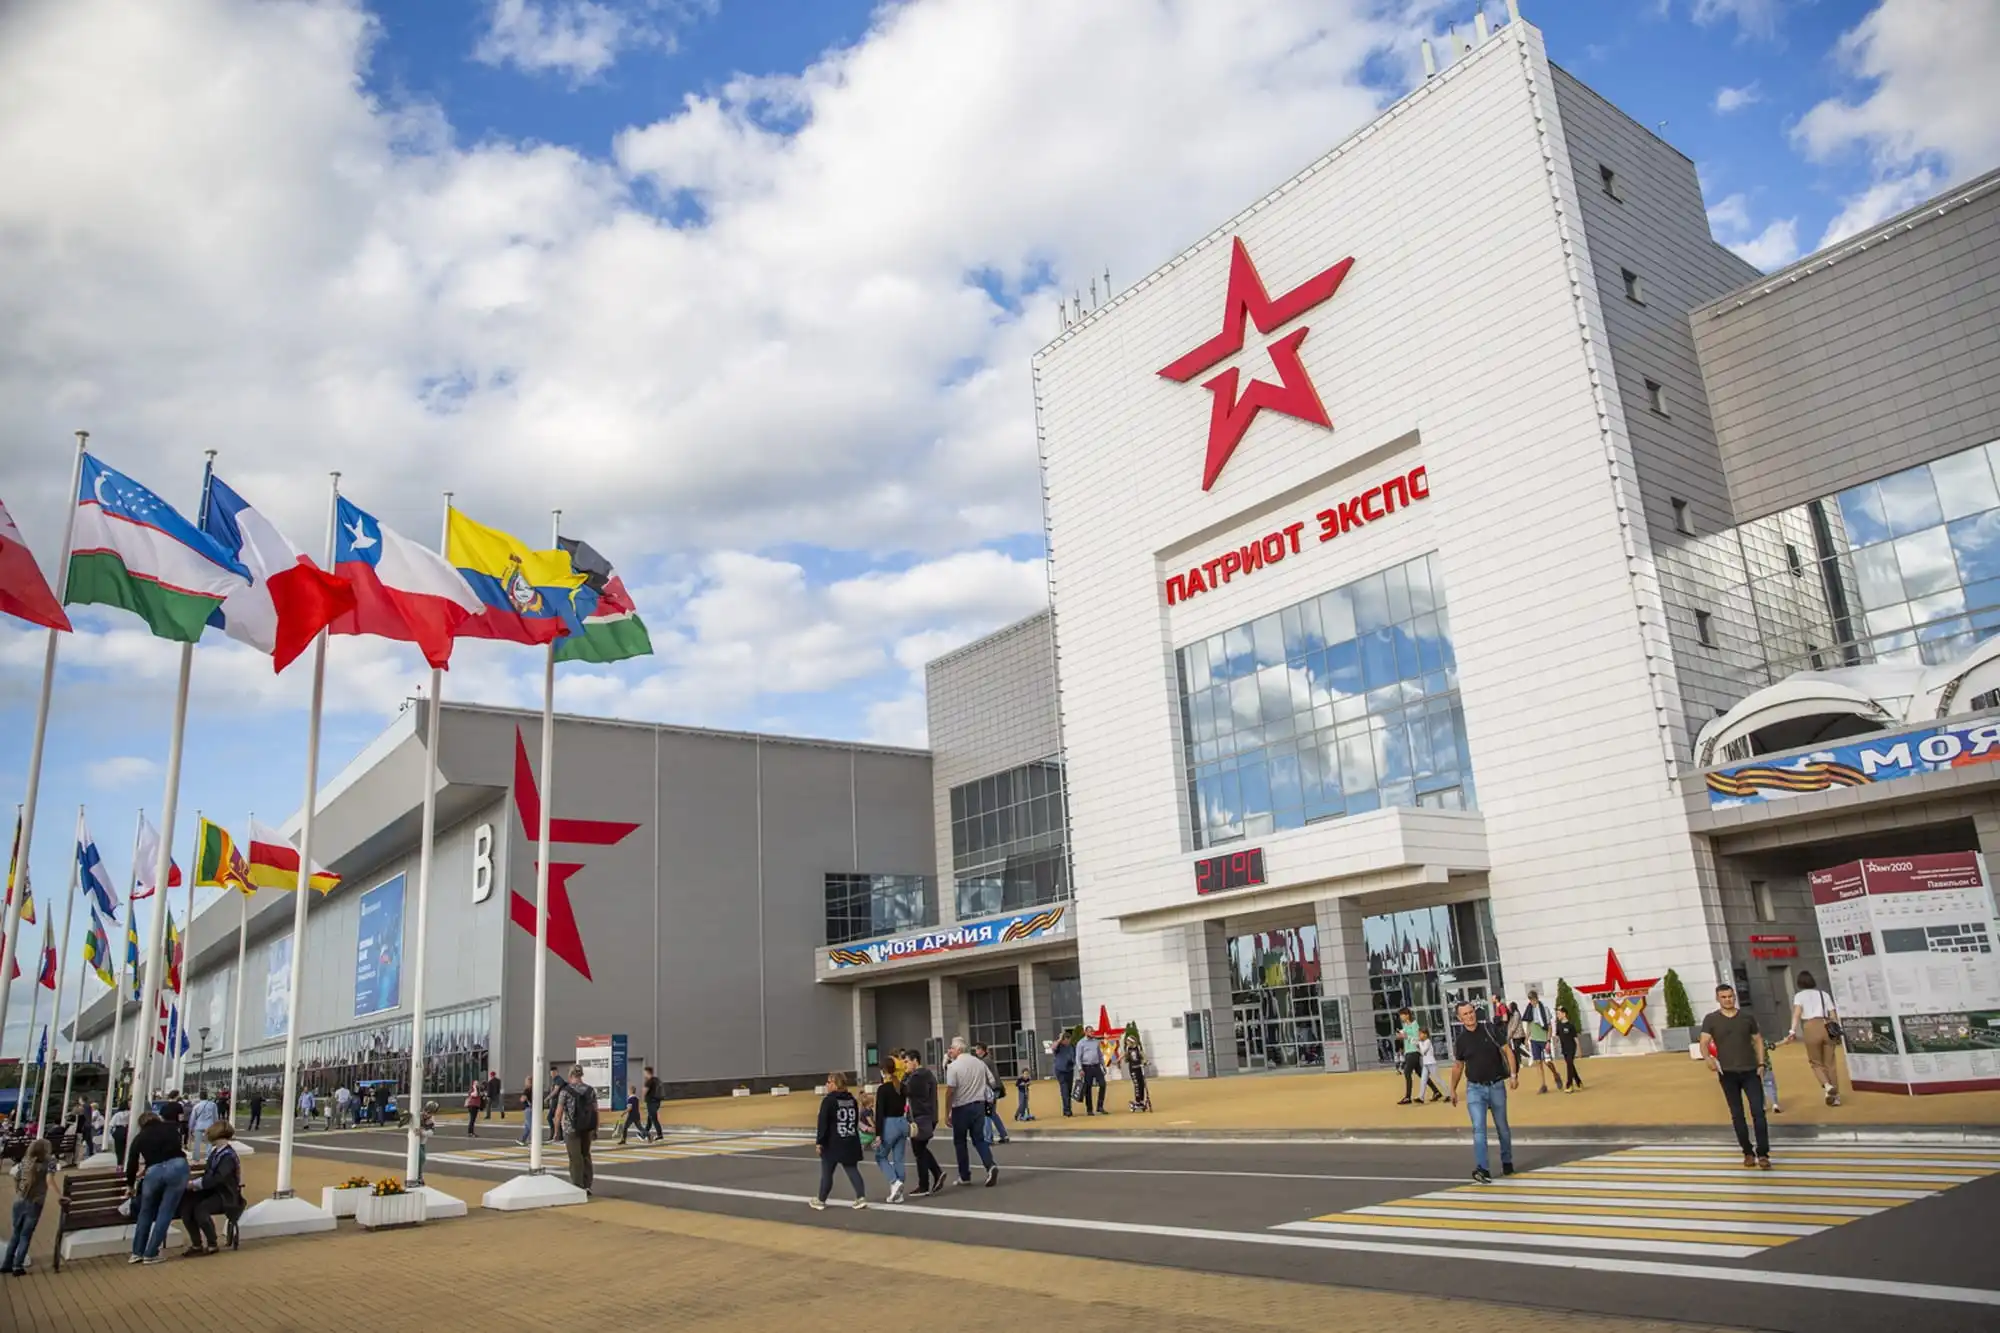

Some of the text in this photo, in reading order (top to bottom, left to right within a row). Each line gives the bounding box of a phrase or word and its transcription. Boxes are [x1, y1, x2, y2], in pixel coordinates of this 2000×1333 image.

[1165, 521, 1304, 606] ПАТРИОТ
[1859, 724, 2000, 776] МОЯ
[880, 925, 992, 958] МОЯ АРМИЯ
